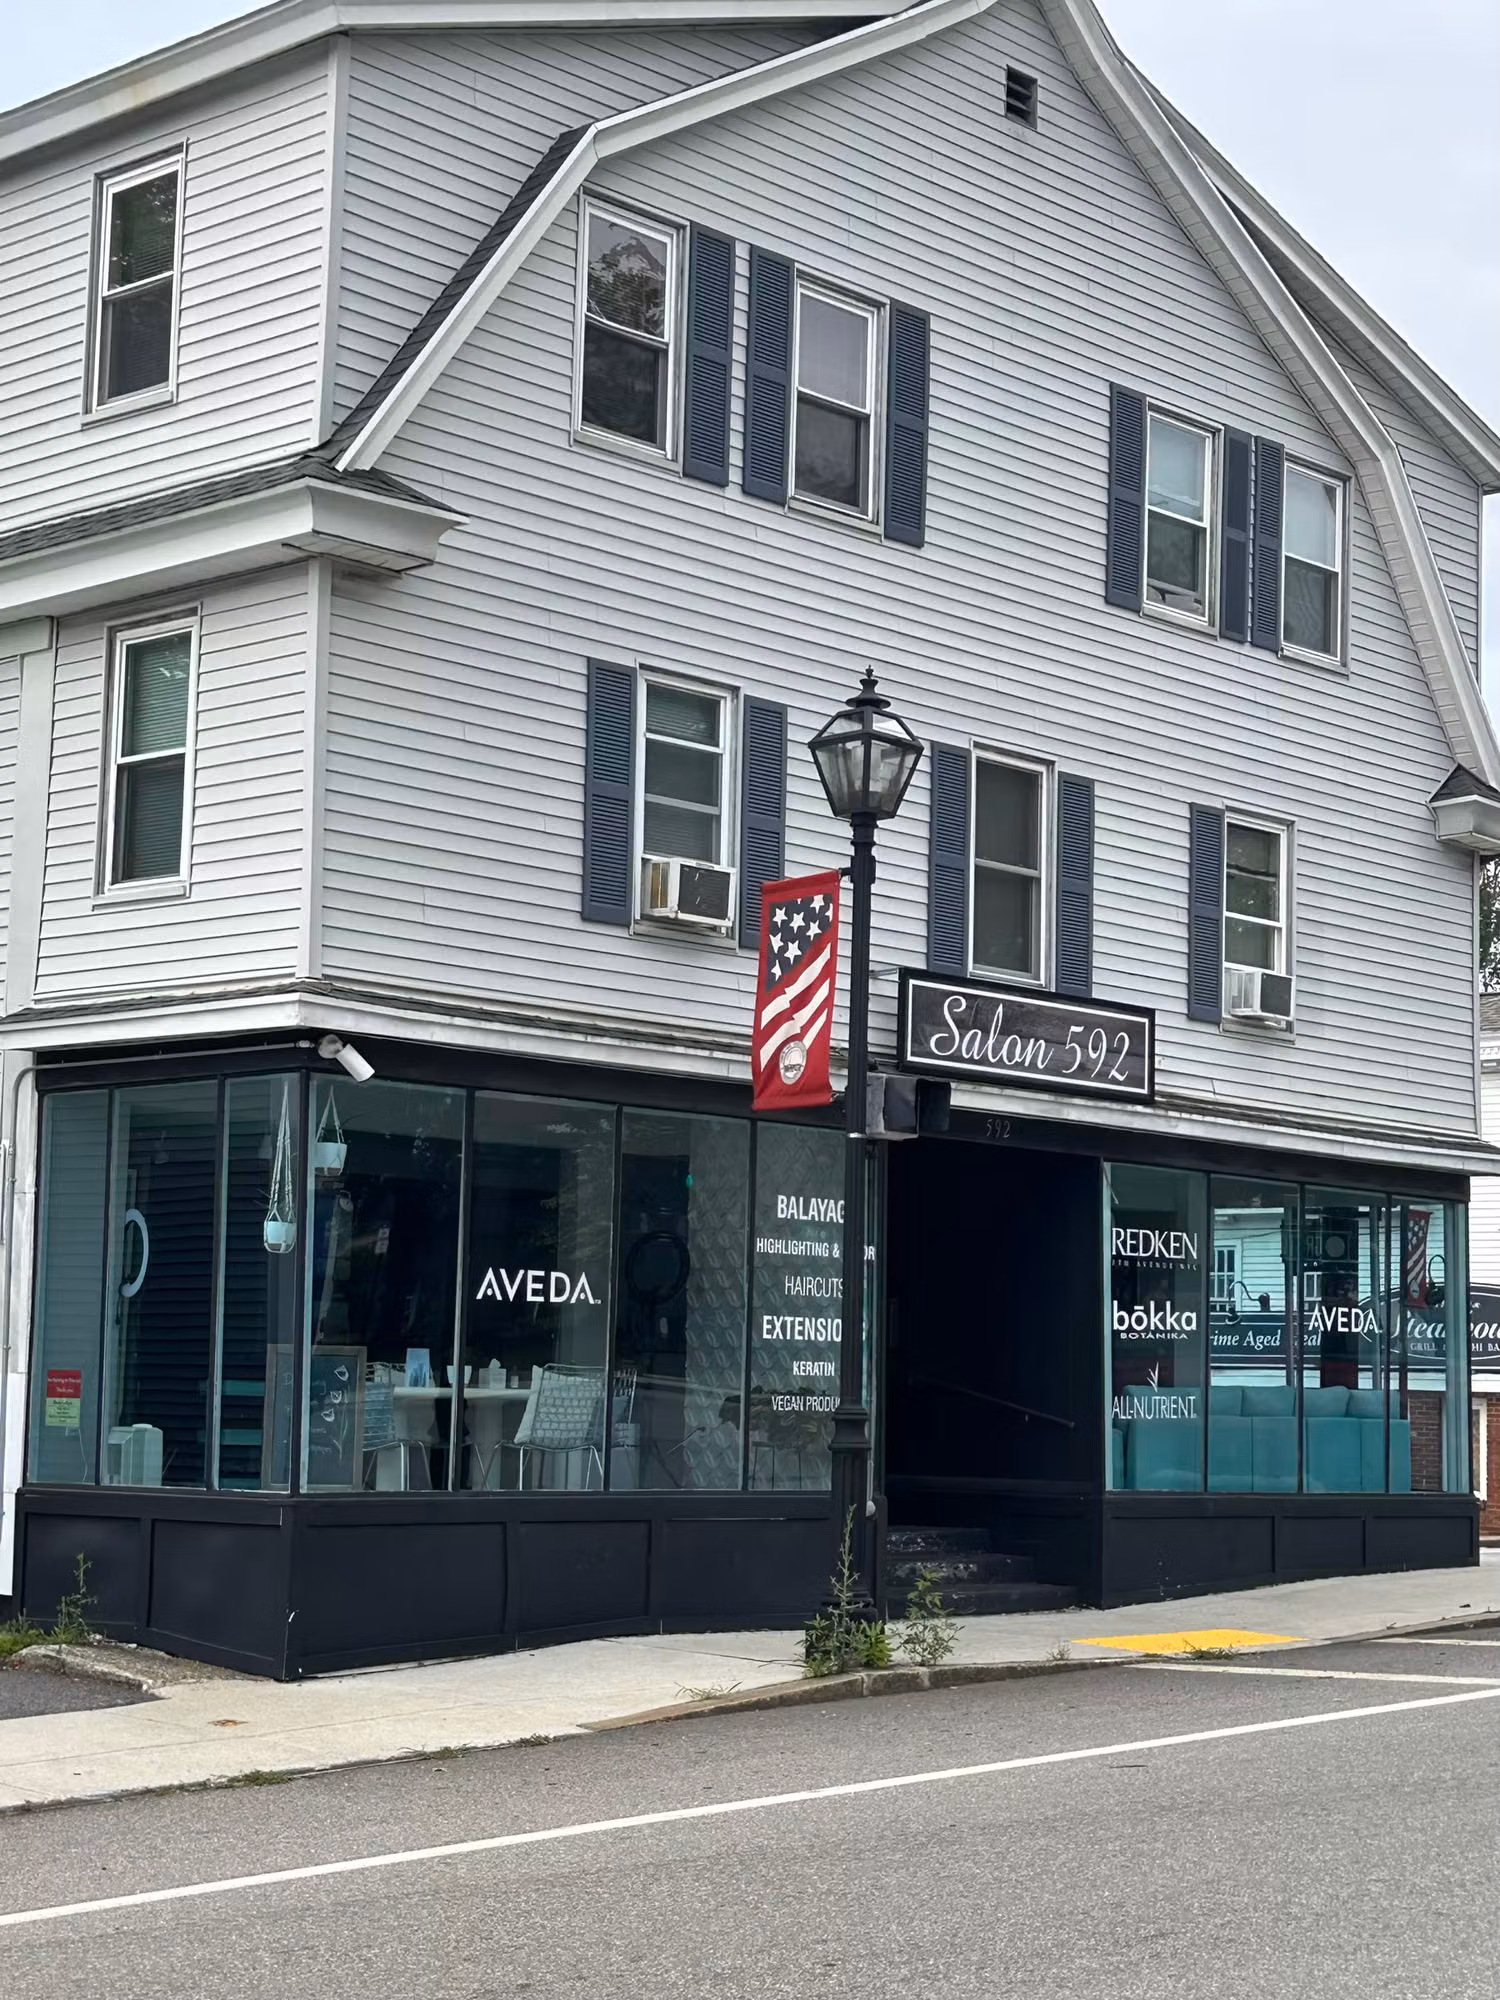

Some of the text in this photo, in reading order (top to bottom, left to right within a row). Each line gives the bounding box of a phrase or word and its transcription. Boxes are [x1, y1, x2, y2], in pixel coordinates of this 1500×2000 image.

[929, 996, 1130, 1082] Salon 592
[985, 1118, 1011, 1138] 592
[777, 1194, 845, 1224] BALAYAG
[756, 1237, 840, 1258] HIGHLIGHTING &
[1111, 1227, 1198, 1260] REDKEN
[475, 1266, 597, 1305] AVEDA
[762, 1315, 843, 1342] EXTENSIO
[1112, 1300, 1198, 1331] bōkka
[1308, 1303, 1380, 1334] AVEDA
[1209, 1330, 1240, 1347] ime
[1242, 1329, 1281, 1351] Aged
[792, 1361, 835, 1376] KERATIN
[771, 1395, 841, 1412] VEGAN PRODU
[1111, 1395, 1197, 1420] ALL-NUTRIENT
